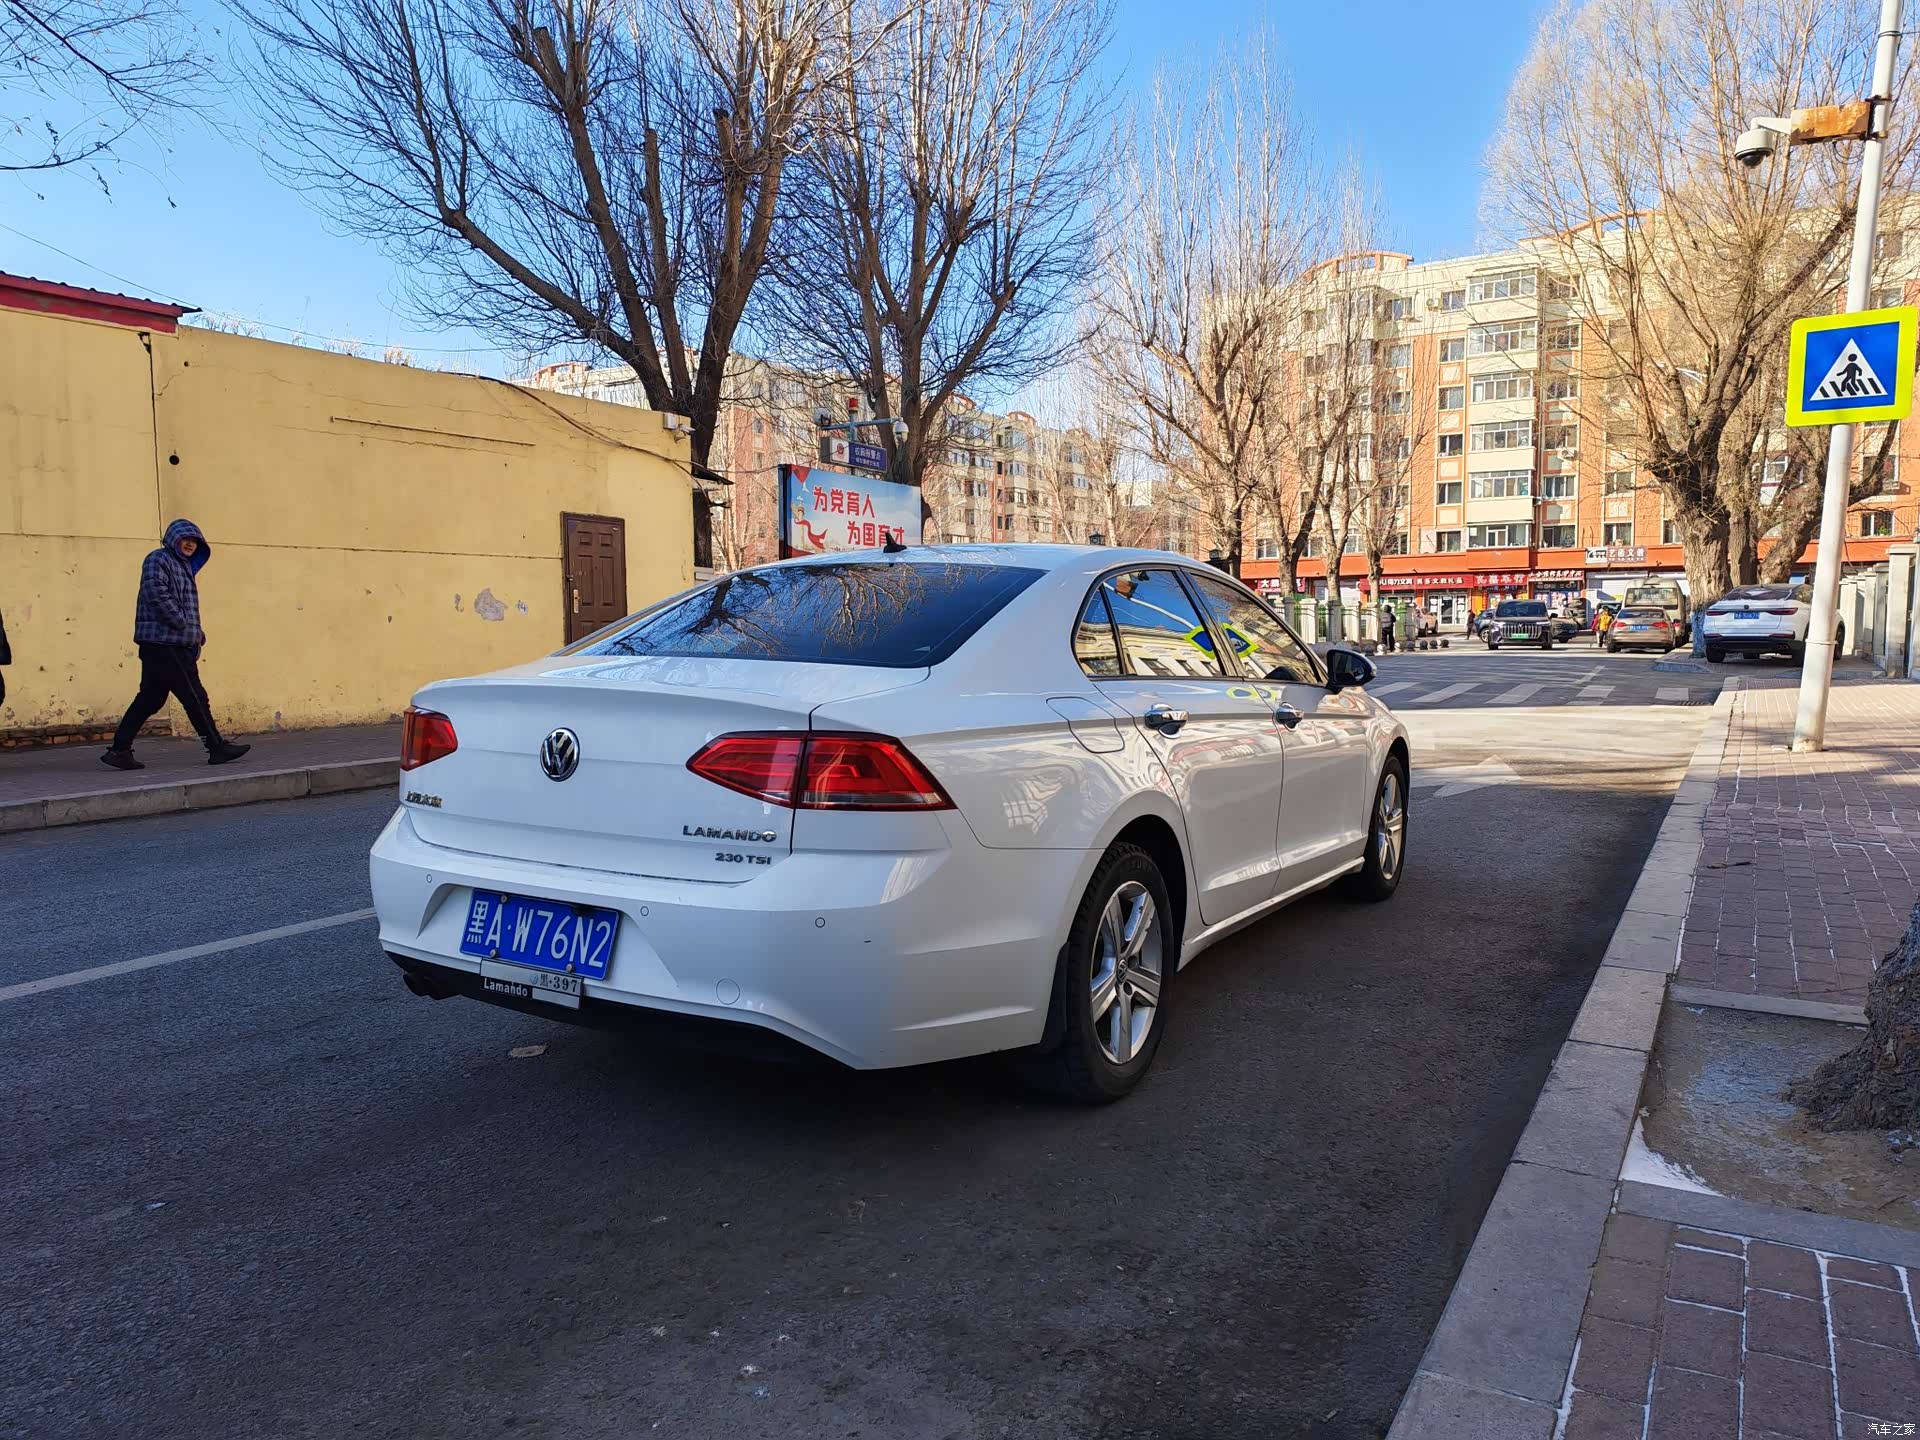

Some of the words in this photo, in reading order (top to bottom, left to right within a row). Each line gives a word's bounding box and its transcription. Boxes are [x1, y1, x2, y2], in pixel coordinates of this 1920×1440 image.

[813, 486, 875, 518] 为党育人
[847, 521, 905, 547] 为国育才
[682, 825, 777, 842] LAMANDO
[715, 852, 743, 864] 230
[746, 854, 772, 865] TSI
[483, 977, 528, 997] Lamando
